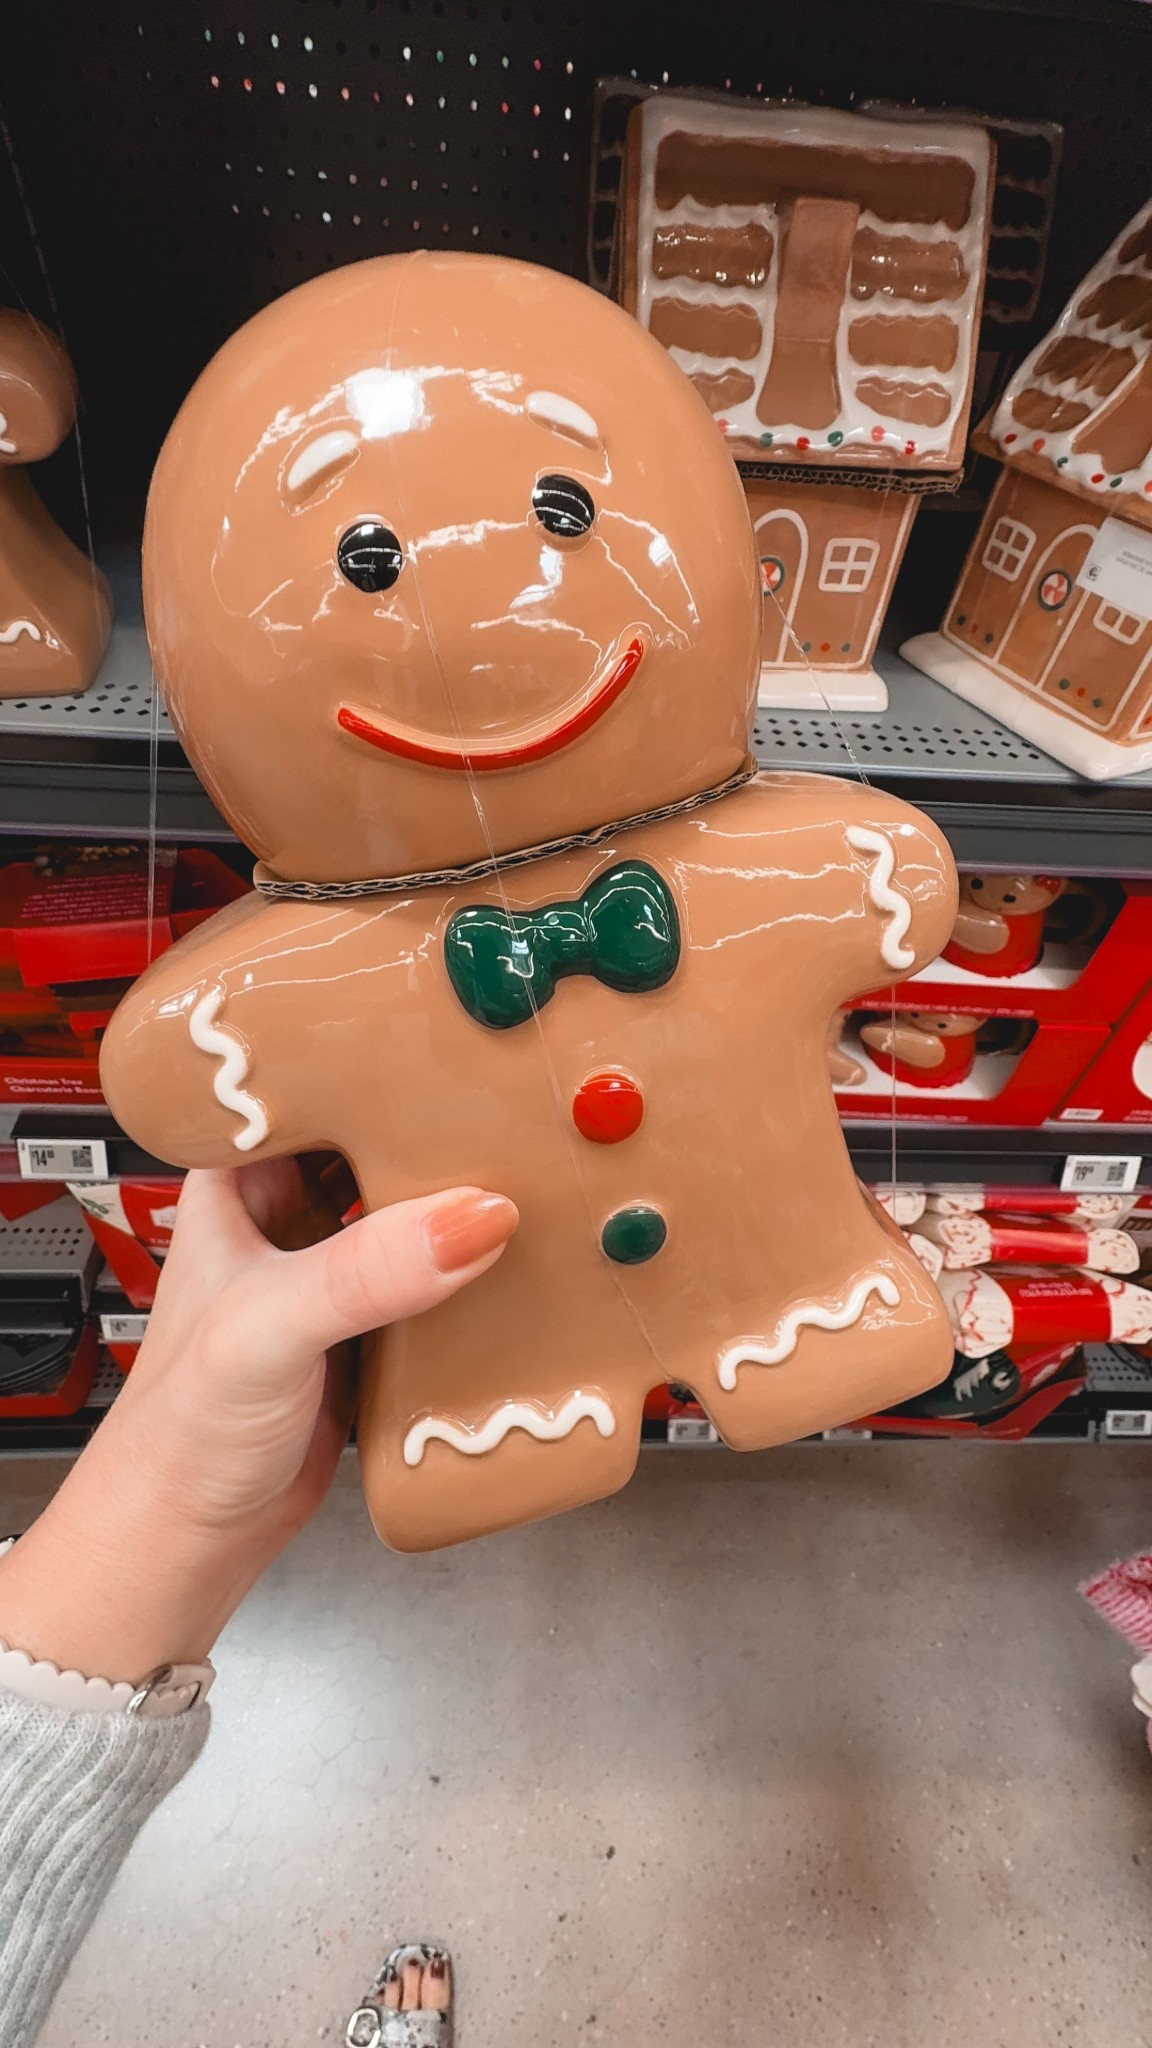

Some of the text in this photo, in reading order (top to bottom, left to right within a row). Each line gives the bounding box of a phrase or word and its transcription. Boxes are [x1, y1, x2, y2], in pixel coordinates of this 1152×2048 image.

[4, 1076, 83, 1086] Christmas Tree
[10, 1085, 73, 1094] Charcuterie
